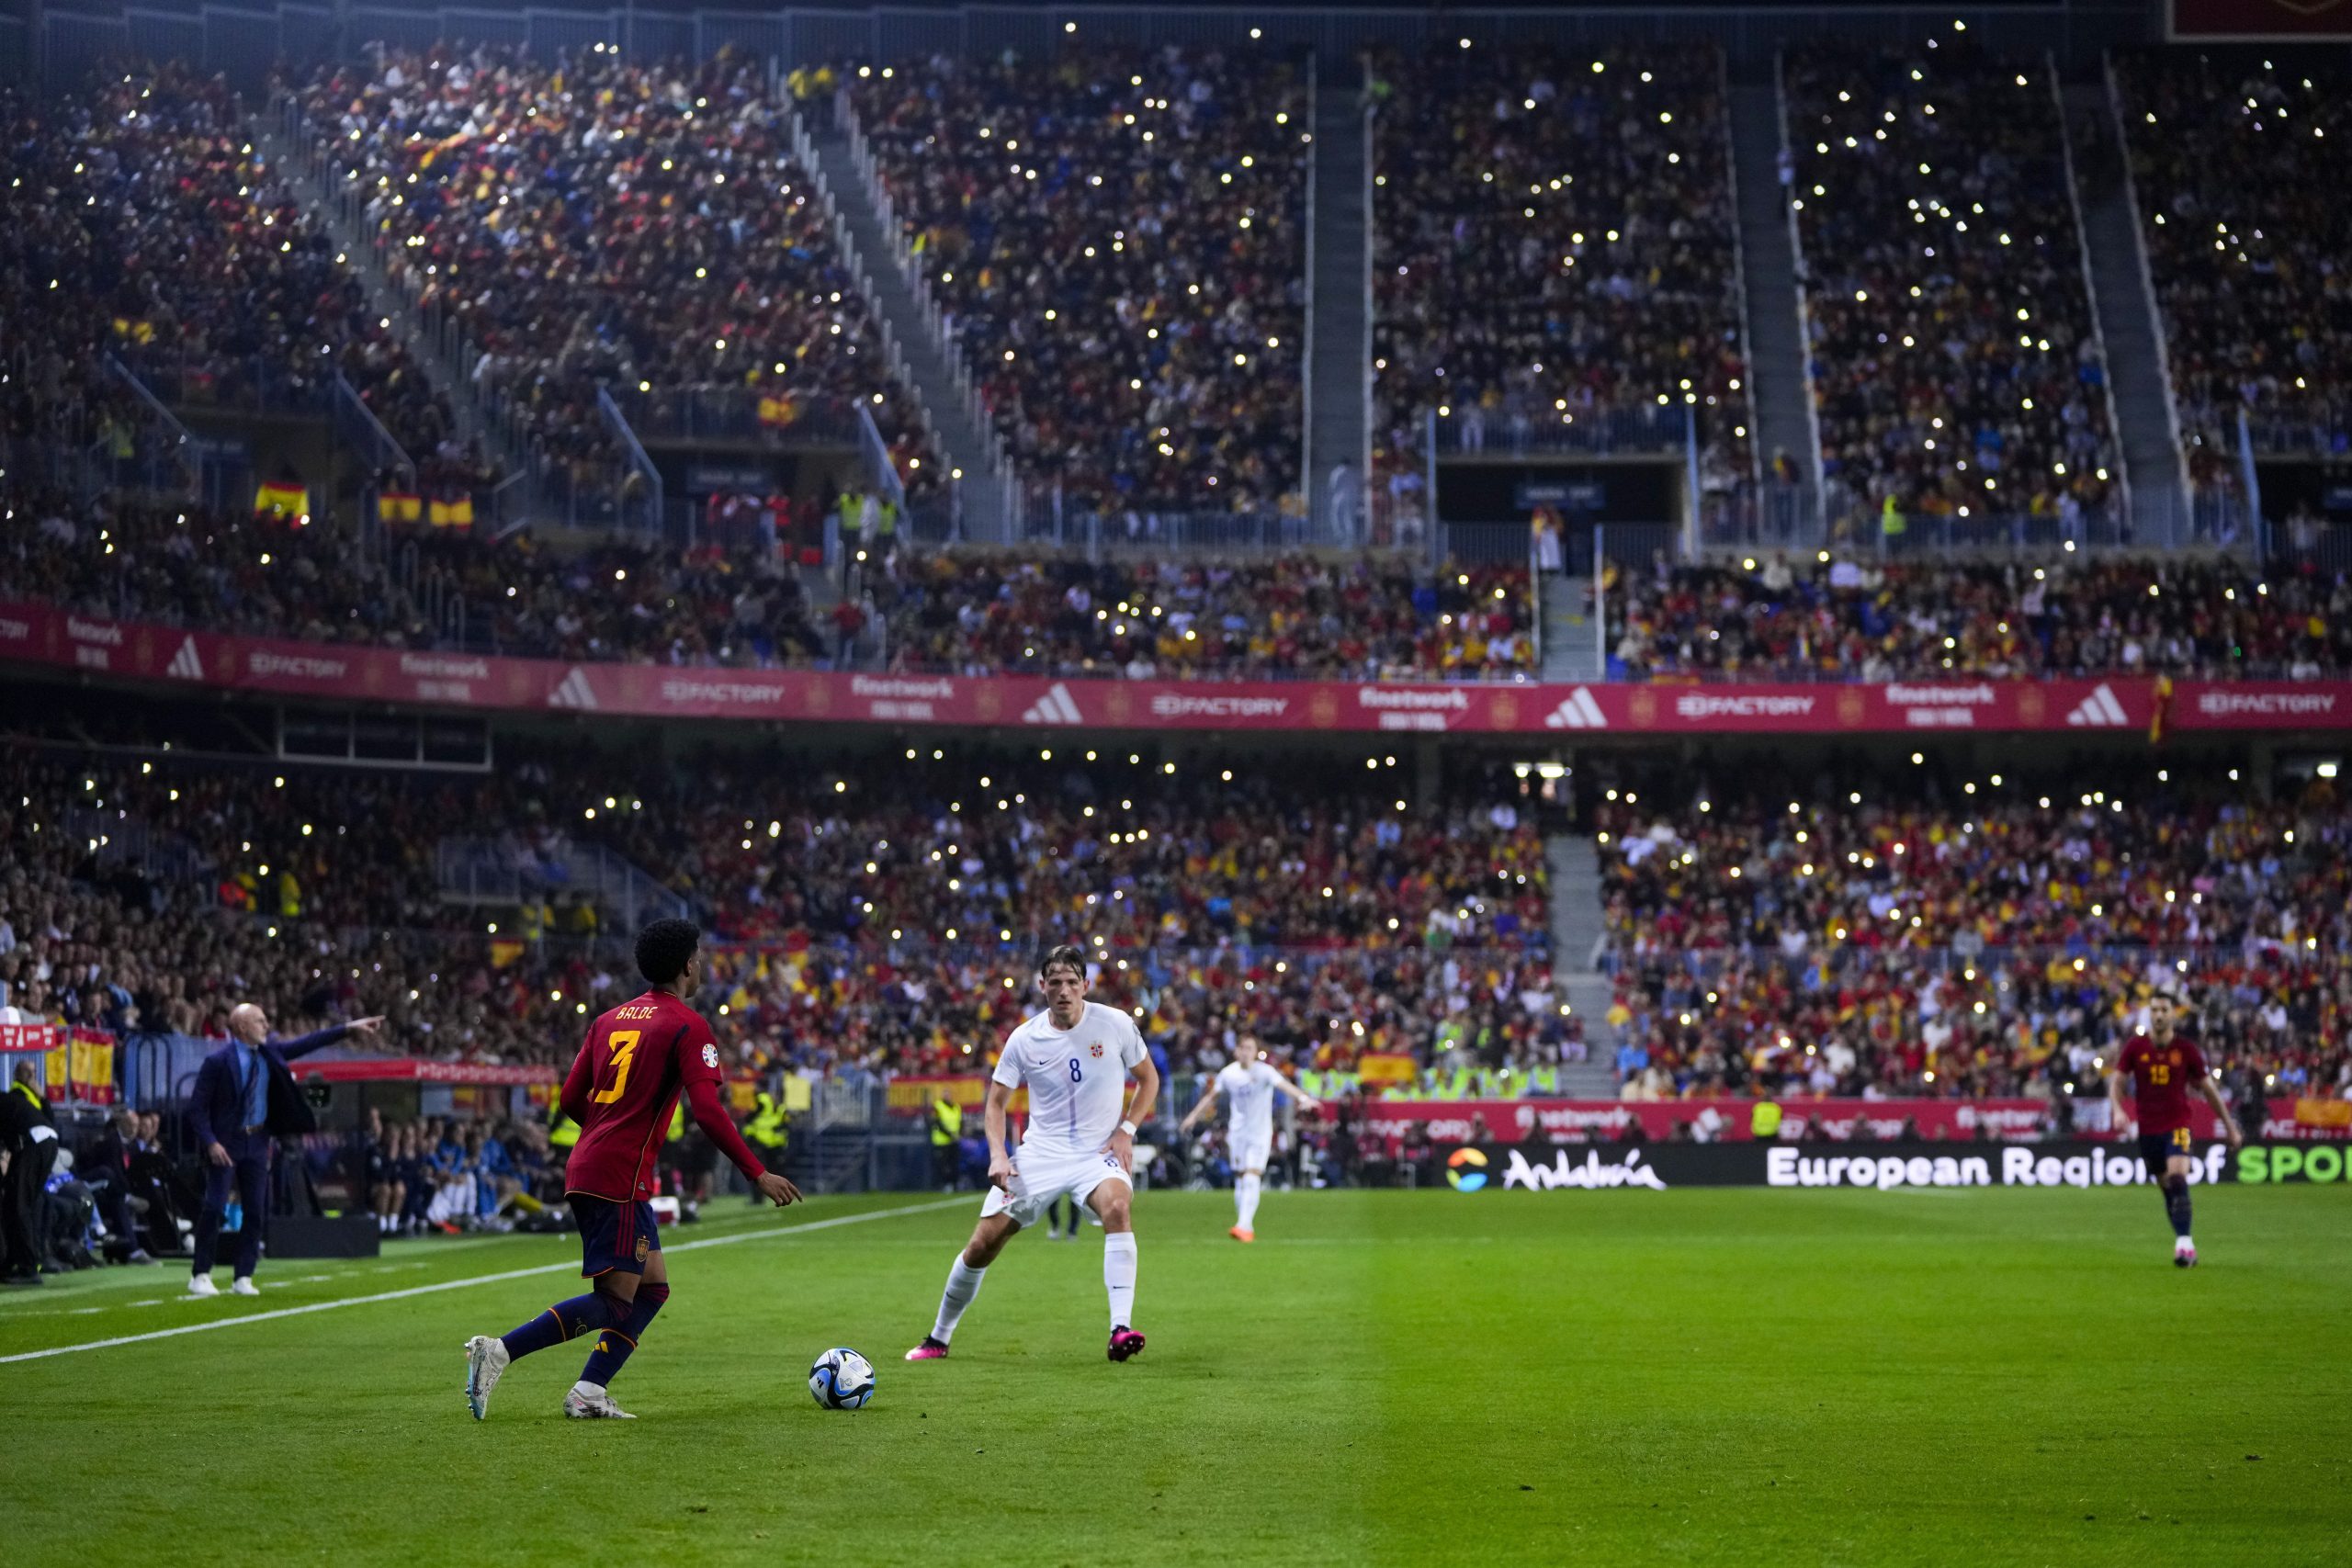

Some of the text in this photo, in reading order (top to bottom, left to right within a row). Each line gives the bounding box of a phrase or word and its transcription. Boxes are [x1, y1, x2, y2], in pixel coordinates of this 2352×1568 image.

[616, 1006, 659, 1021] BALDE
[594, 1030, 641, 1104] 3
[1069, 1058, 1082, 1083] 8
[1767, 1146, 1992, 1191] European
[2236, 1145, 2352, 1184] SPO
